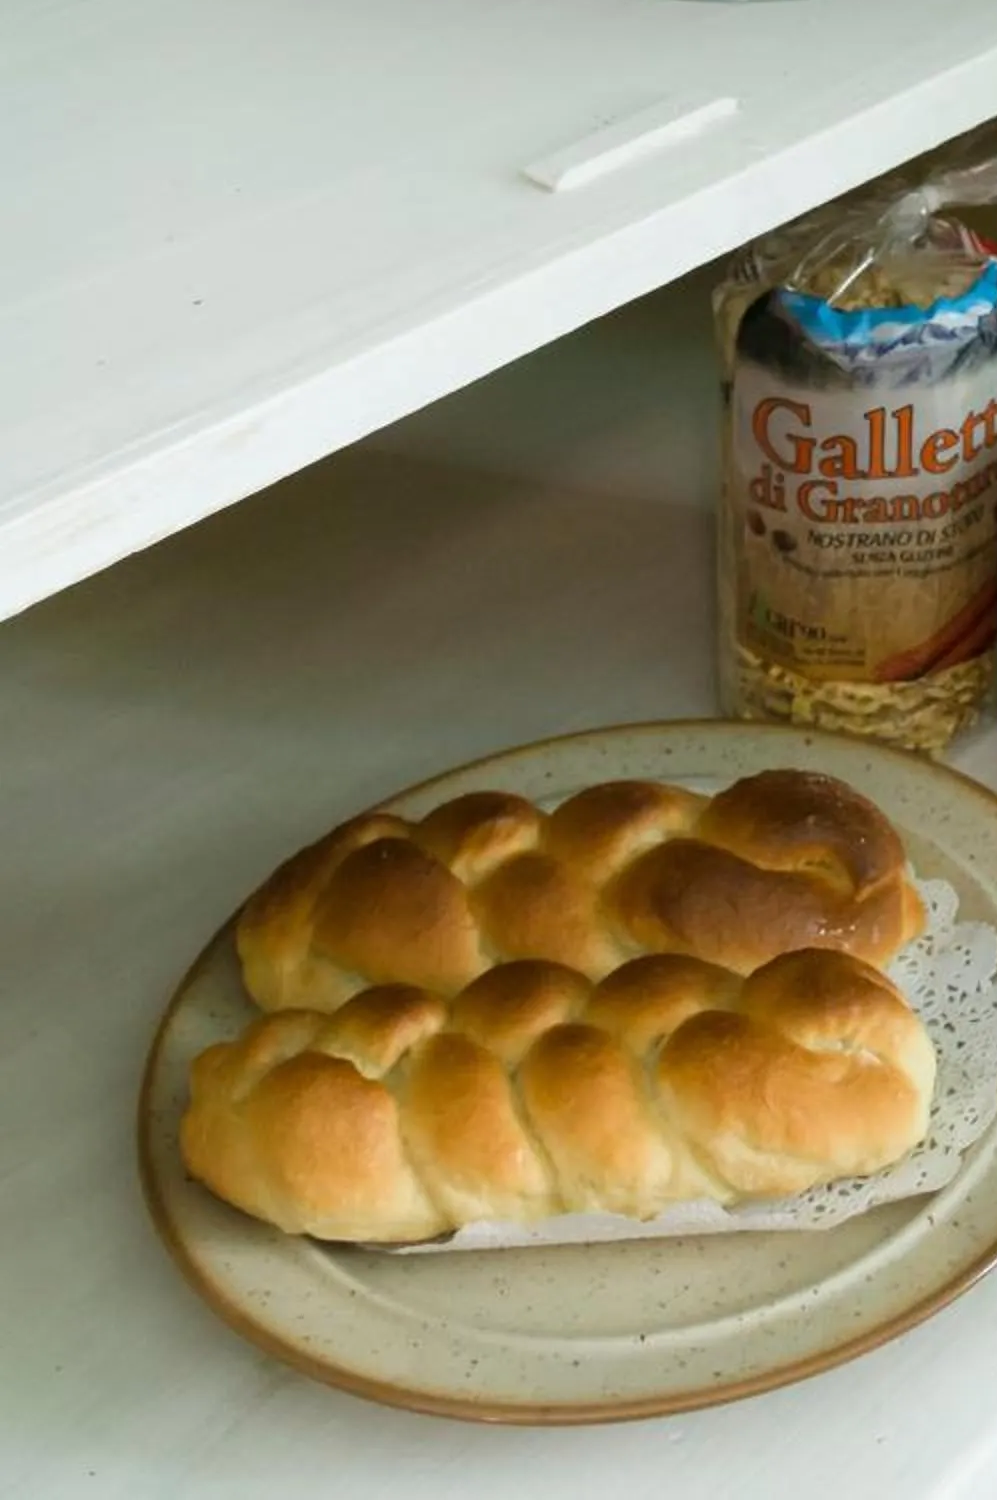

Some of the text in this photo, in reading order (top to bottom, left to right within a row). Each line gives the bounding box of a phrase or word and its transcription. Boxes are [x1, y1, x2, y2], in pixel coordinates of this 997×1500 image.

[750, 463, 787, 512] di
[808, 528, 912, 549] NOSTRANO
[916, 528, 936, 546] DI
